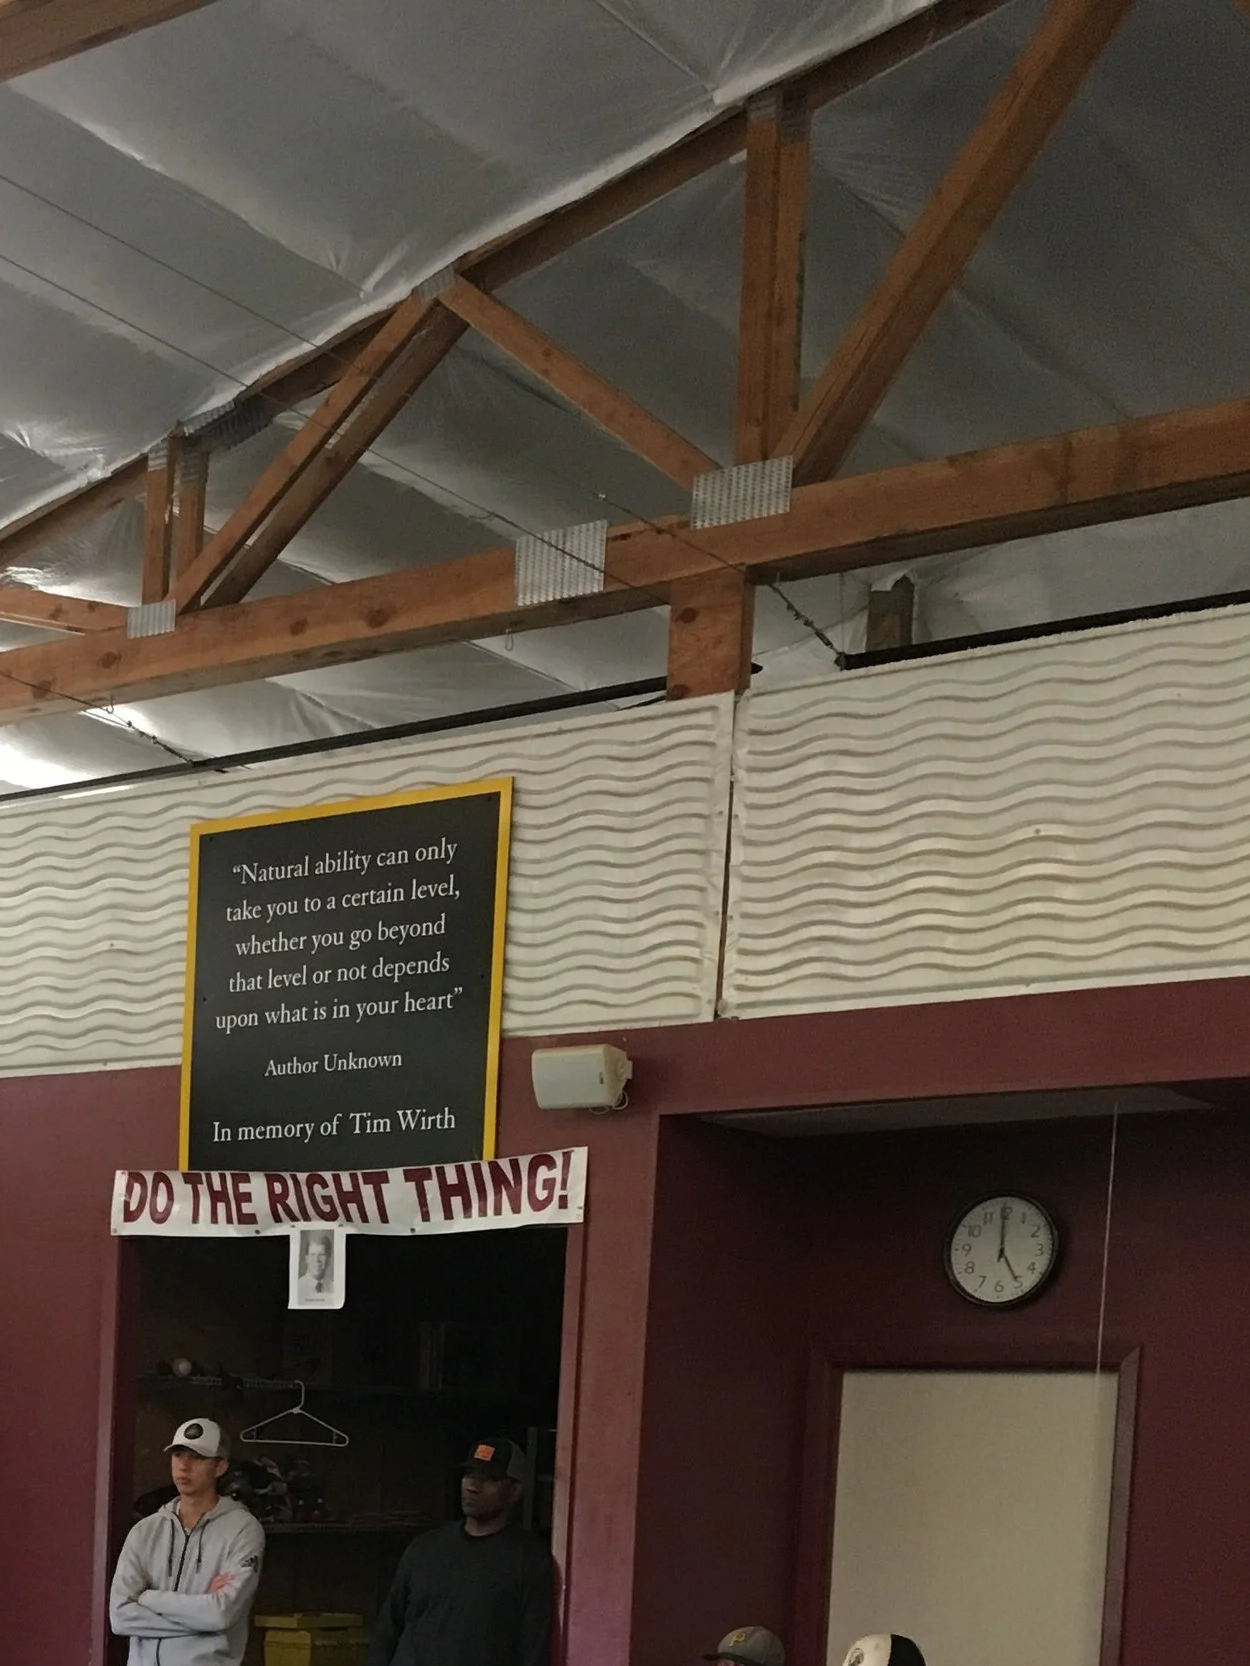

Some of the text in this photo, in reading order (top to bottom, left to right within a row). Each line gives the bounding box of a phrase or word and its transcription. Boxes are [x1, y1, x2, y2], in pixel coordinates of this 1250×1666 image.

[232, 837, 458, 885] “Natural ability can only
[226, 873, 460, 924] take you to a certain level,
[235, 912, 446, 956] whether you go beyond
[229, 950, 450, 993] that level or not depends
[215, 986, 464, 1036] upon what is in your heart”
[264, 1051, 402, 1077] Author Unknown
[213, 1106, 455, 1144] In memory of Tim Wirth
[123, 1150, 573, 1225] DO THE RIGHT THING!
[1021, 1212, 1027, 1224] 1
[967, 1223, 982, 1238] 10
[1030, 1224, 1041, 1238] 2
[962, 1243, 972, 1257] 9
[1035, 1243, 1045, 1257] 3
[964, 1261, 975, 1275] 8
[1027, 1262, 1036, 1274] 4
[978, 1275, 987, 1289] 7
[994, 1281, 1004, 1293] 6
[729, 1631, 746, 1647] P
